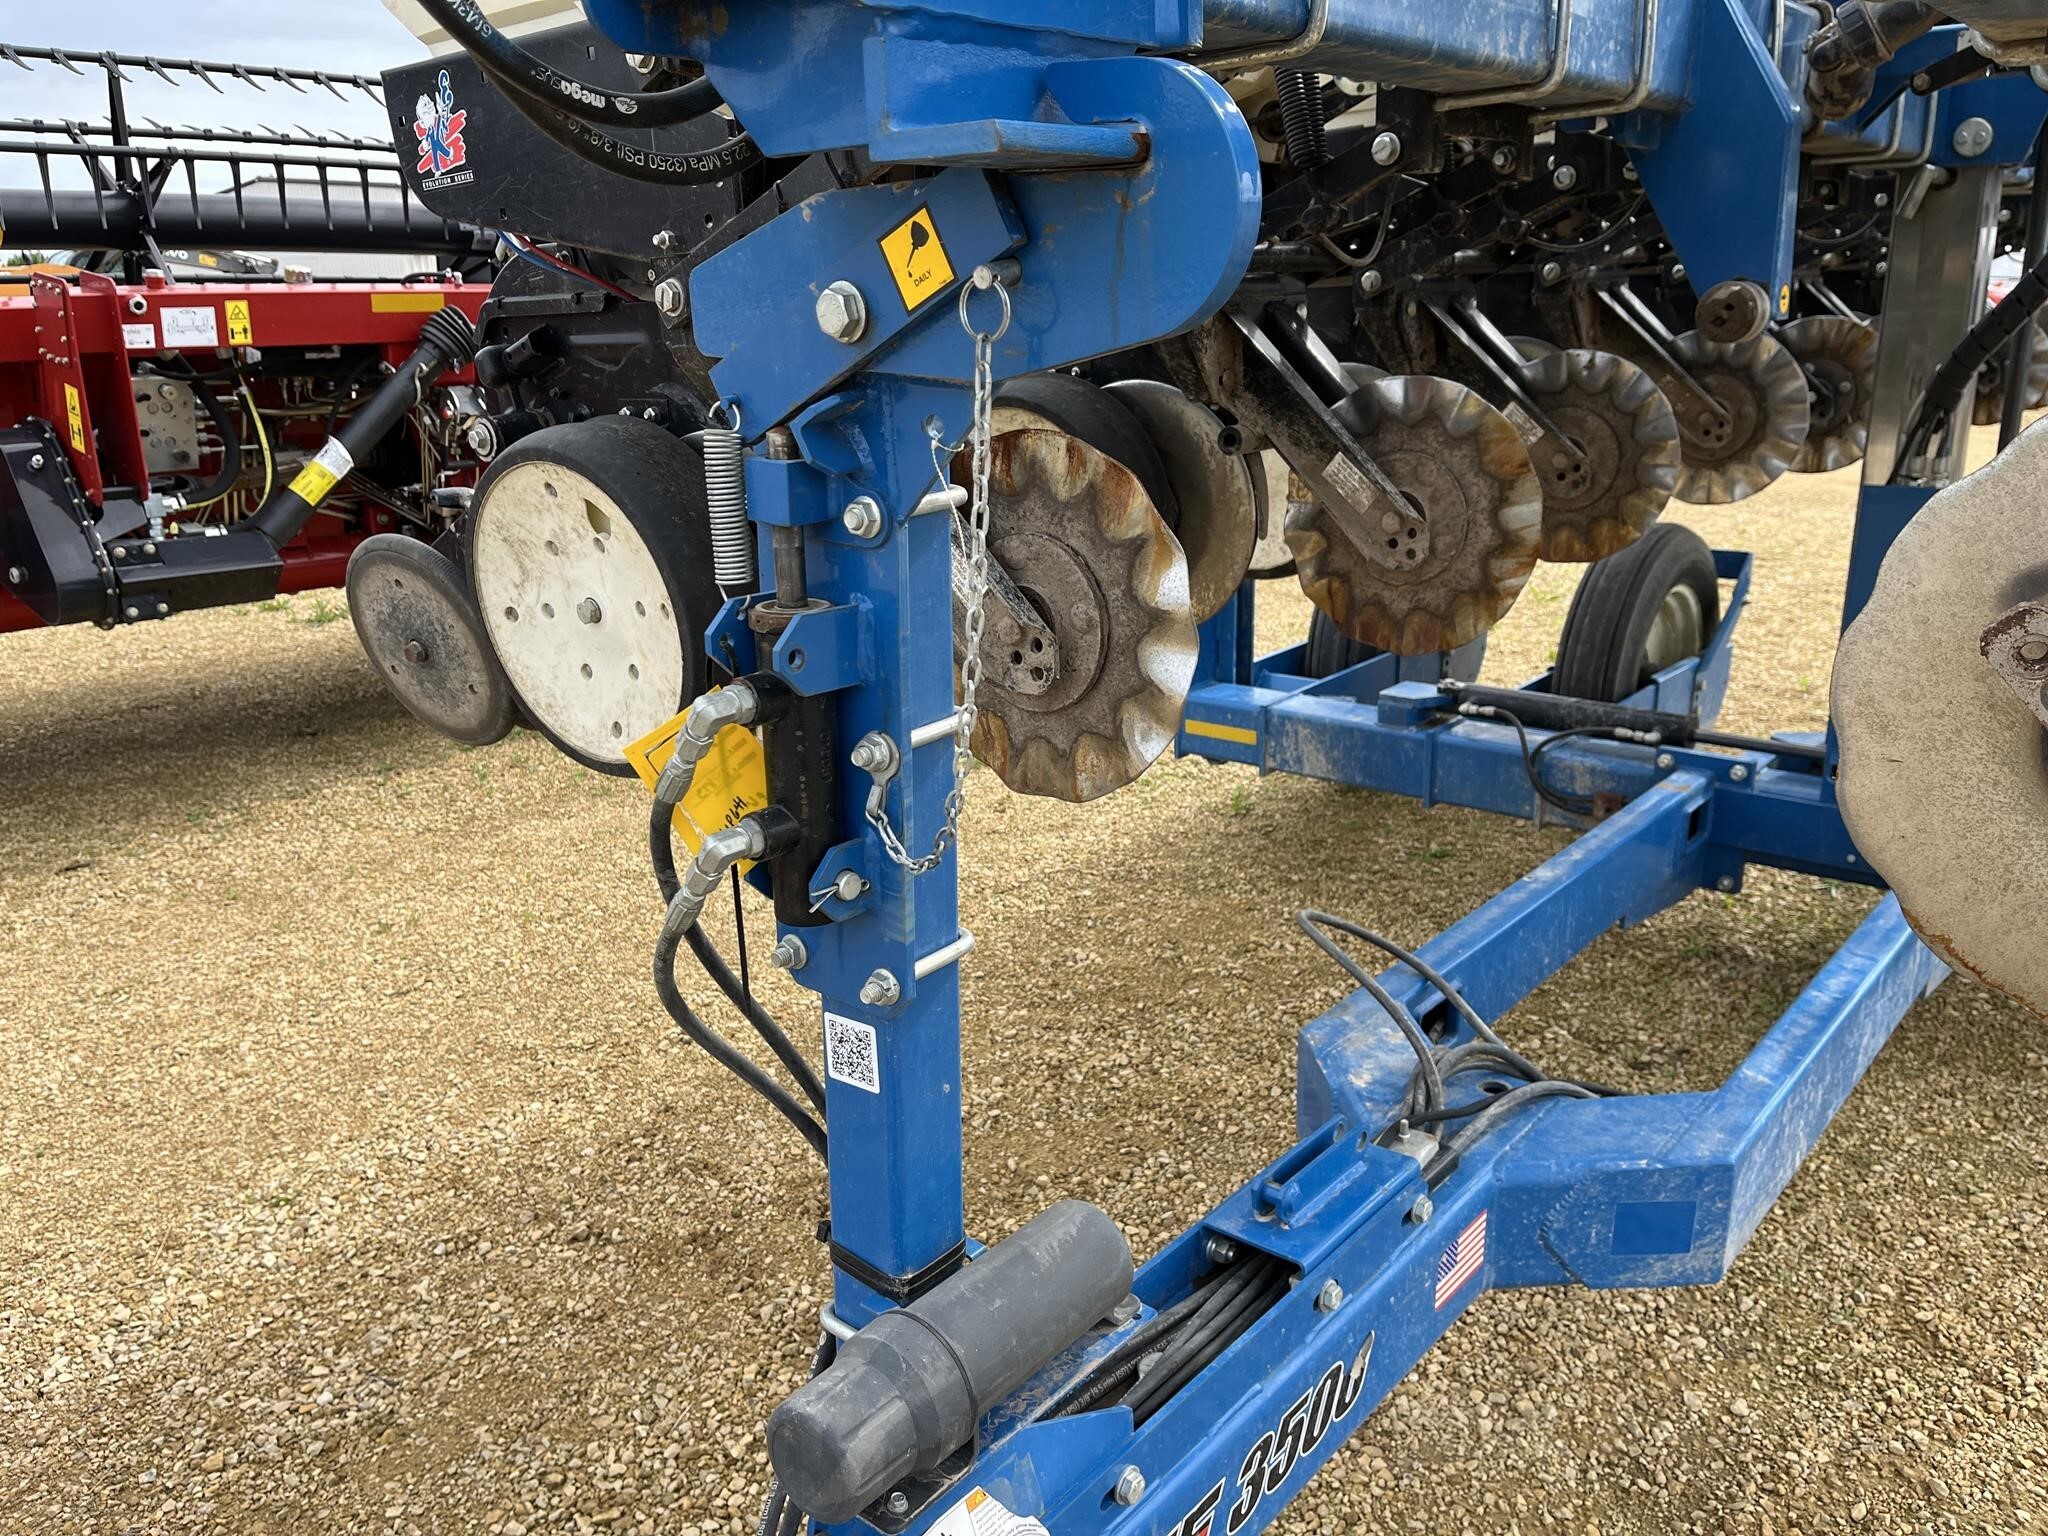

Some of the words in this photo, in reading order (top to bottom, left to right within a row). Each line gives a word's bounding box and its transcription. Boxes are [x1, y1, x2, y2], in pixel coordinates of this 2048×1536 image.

[649, 154, 687, 174] (3250
[688, 154, 721, 172] MPa
[422, 177, 451, 189] EVOLUTION
[454, 172, 474, 182] SERIES
[913, 269, 933, 288] DAILY
